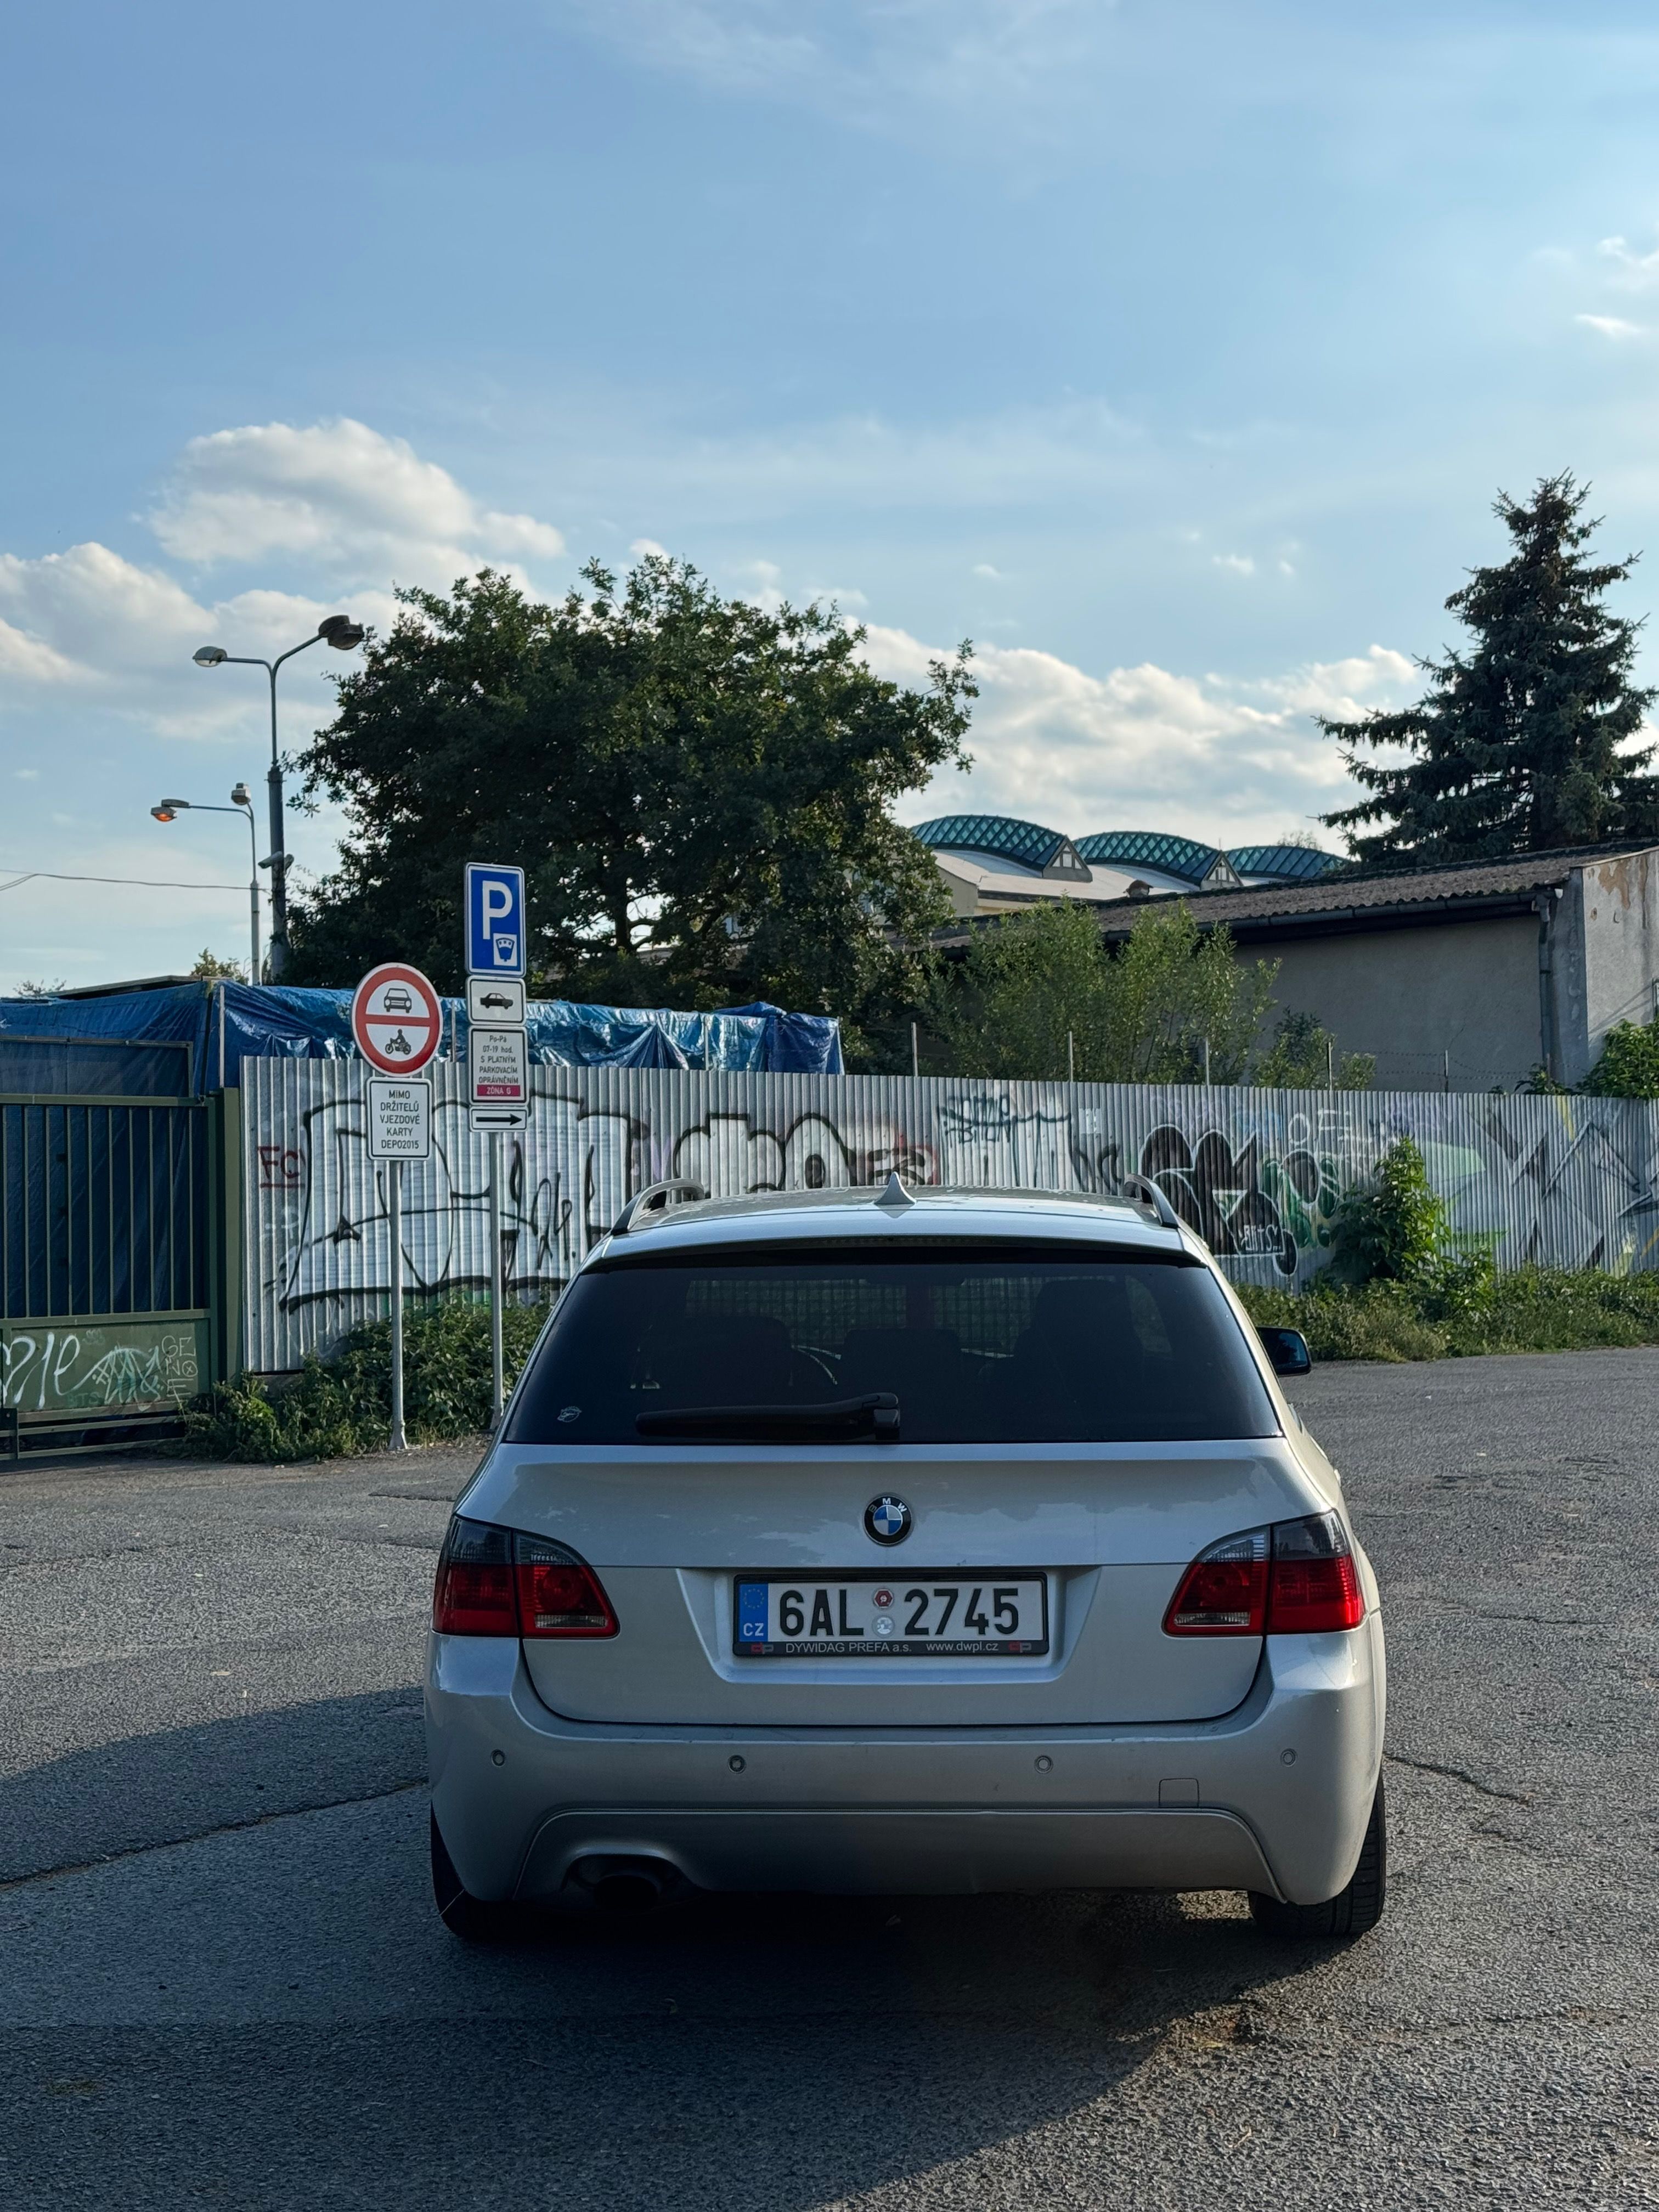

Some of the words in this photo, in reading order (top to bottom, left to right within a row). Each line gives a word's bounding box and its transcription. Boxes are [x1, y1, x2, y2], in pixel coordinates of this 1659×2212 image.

[482, 880, 513, 940] P
[488, 1054, 516, 1063] PLATNÝM
[479, 1065, 517, 1074] PARKOVACÍM
[478, 1075, 518, 1084] OPRÁVNĚNÍM
[389, 1090, 410, 1099] MIMO
[487, 1086, 504, 1094] ZÓNA
[380, 1101, 419, 1112] DRŽITELŮ
[380, 1114, 420, 1125] VJEZDOVÉ
[387, 1127, 413, 1136] KARTY
[381, 1139, 419, 1149] DEPO2015
[868, 1497, 907, 1513] BMW
[743, 1622, 764, 1637] CZ
[780, 1589, 864, 1636] 6AL
[904, 1588, 1019, 1635] 2745
[786, 1643, 845, 1653] DYWIDAG
[849, 1642, 890, 1652] PREFA
[893, 1644, 912, 1652] a.s.
[926, 1641, 998, 1654] www.dwpl.cz
